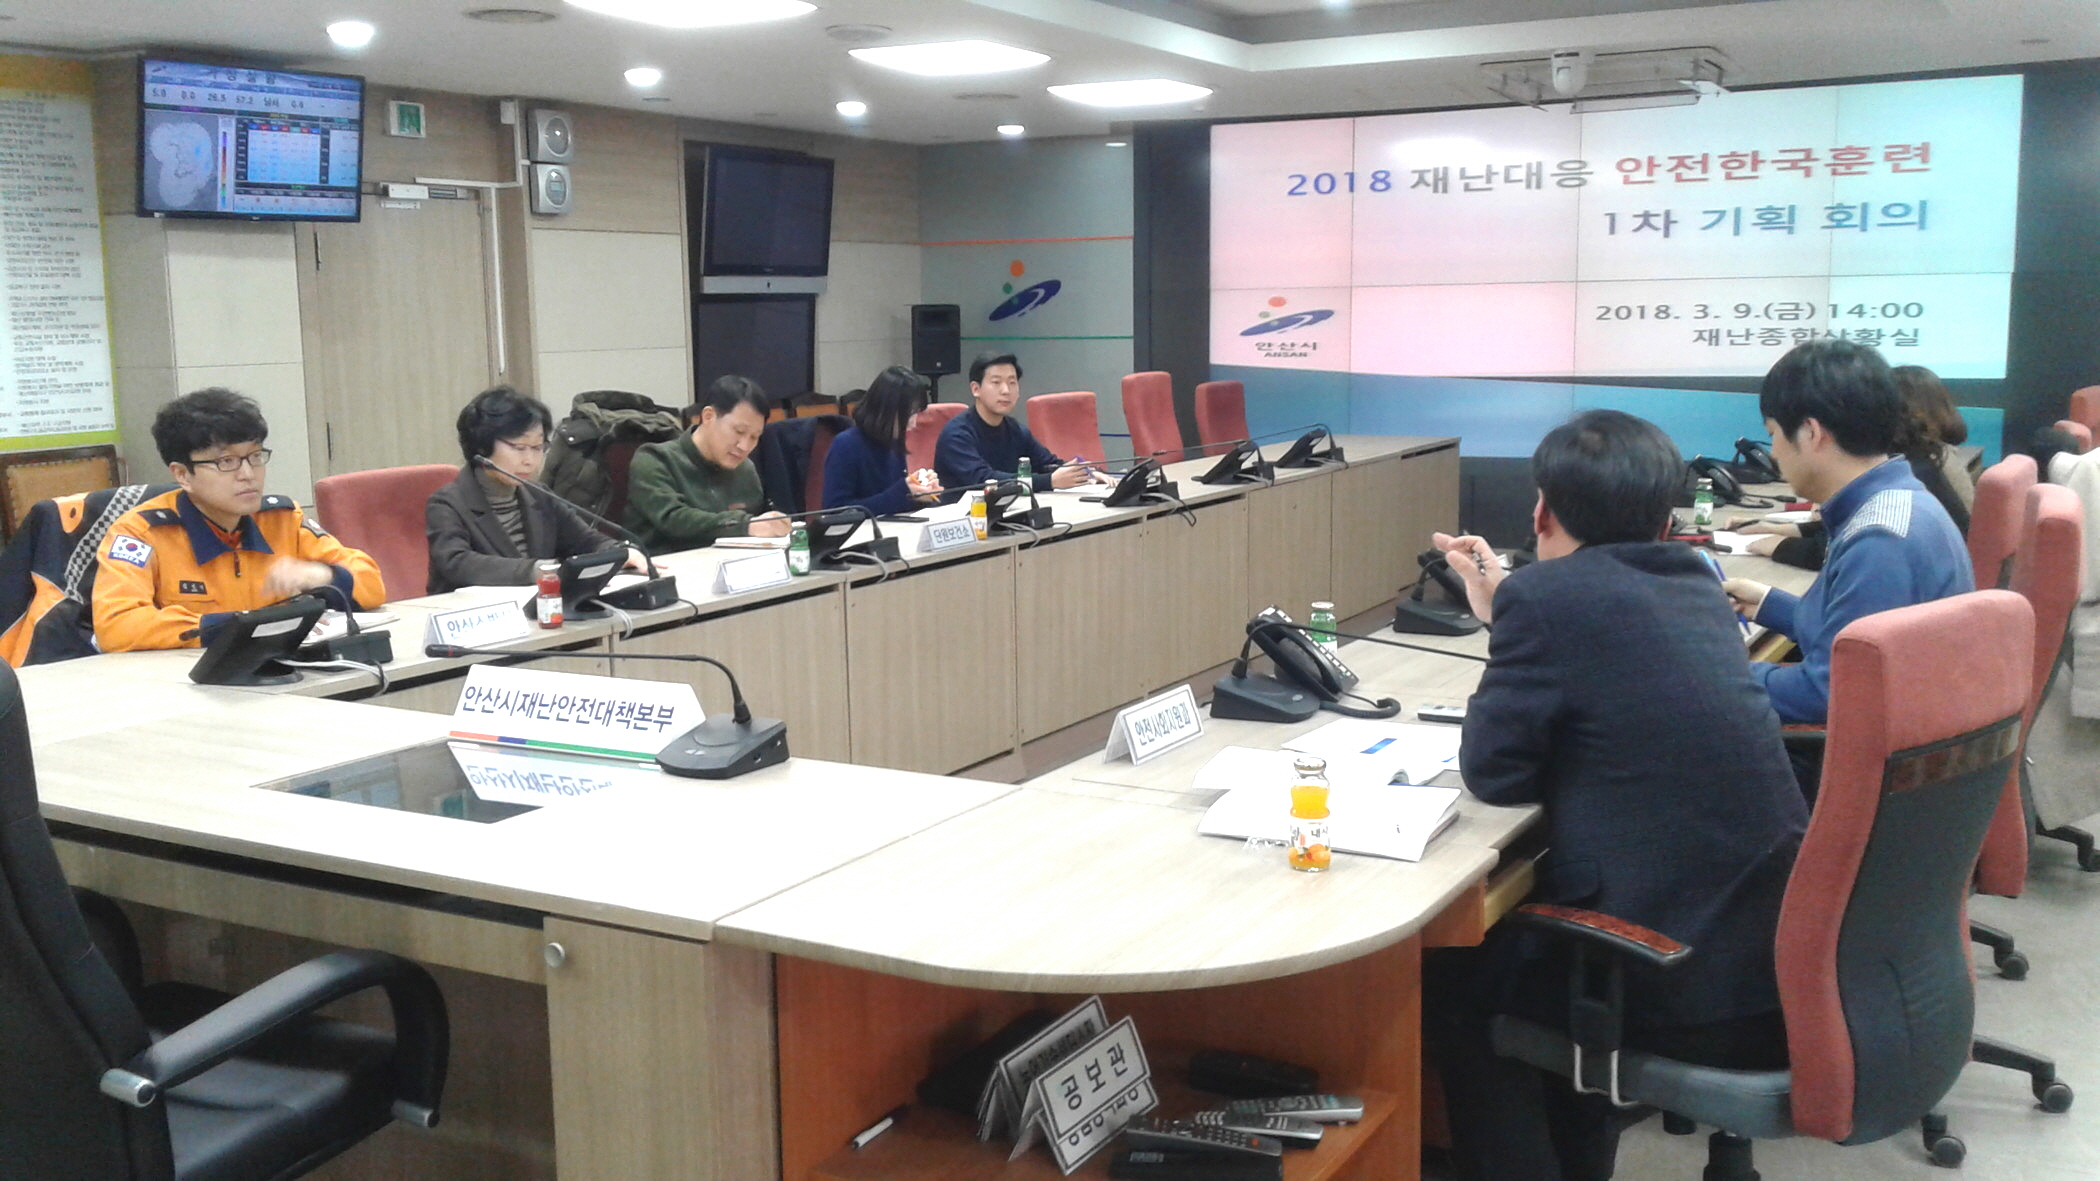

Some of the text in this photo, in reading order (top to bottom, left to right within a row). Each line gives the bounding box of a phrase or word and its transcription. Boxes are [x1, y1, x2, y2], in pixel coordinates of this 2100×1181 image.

[1287, 141, 1931, 196] 2018 재난대응 안전한국훈련
[1604, 199, 1928, 238] 1차 기획 회의
[1595, 303, 1681, 321] 2018.
[1828, 301, 1924, 319] 14:00
[1255, 341, 1317, 351] 안산시
[462, 685, 675, 733] 안산시재난안전대책본부
[1060, 1042, 1128, 1110] 공보관
